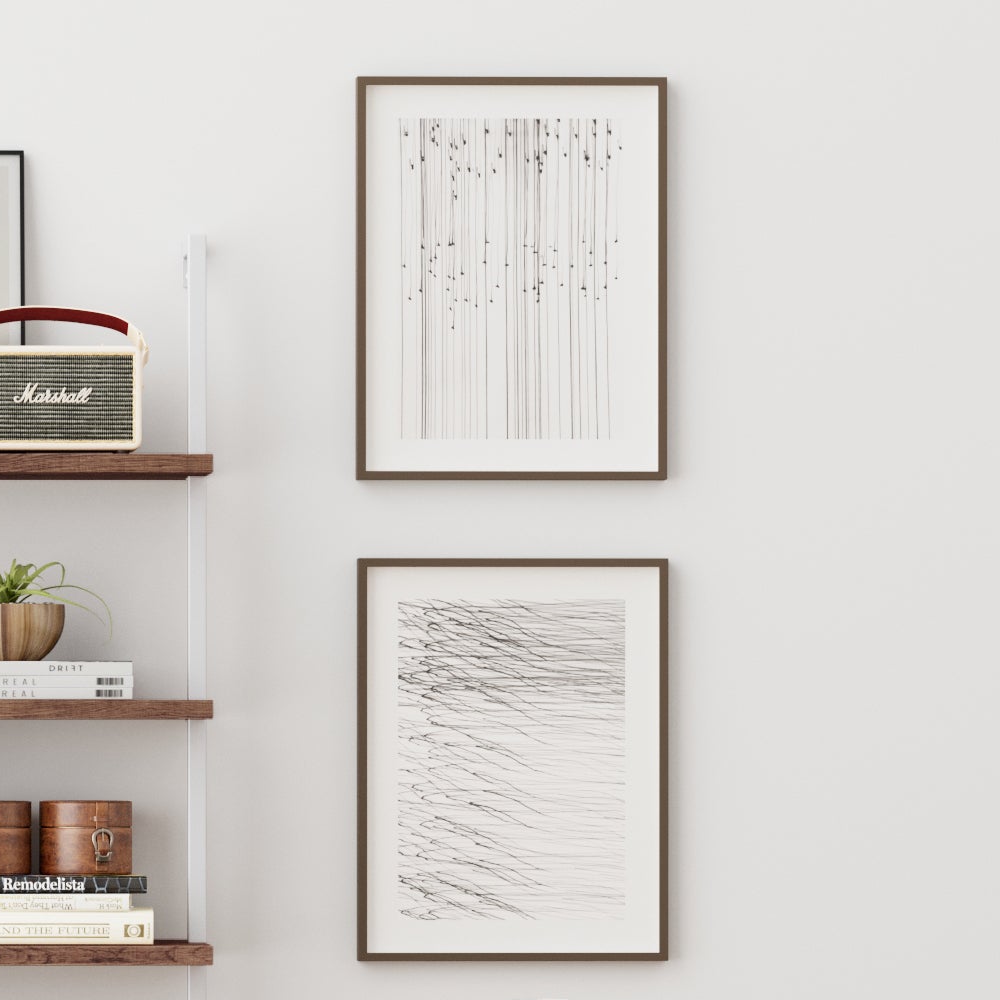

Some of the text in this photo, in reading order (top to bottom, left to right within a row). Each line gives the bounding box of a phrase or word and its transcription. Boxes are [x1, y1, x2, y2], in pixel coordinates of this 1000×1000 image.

[13, 382, 93, 404] Marshall
[2, 877, 85, 891] Remodelista
[25, 926, 53, 935] THE
[57, 926, 110, 935] FUTURE
